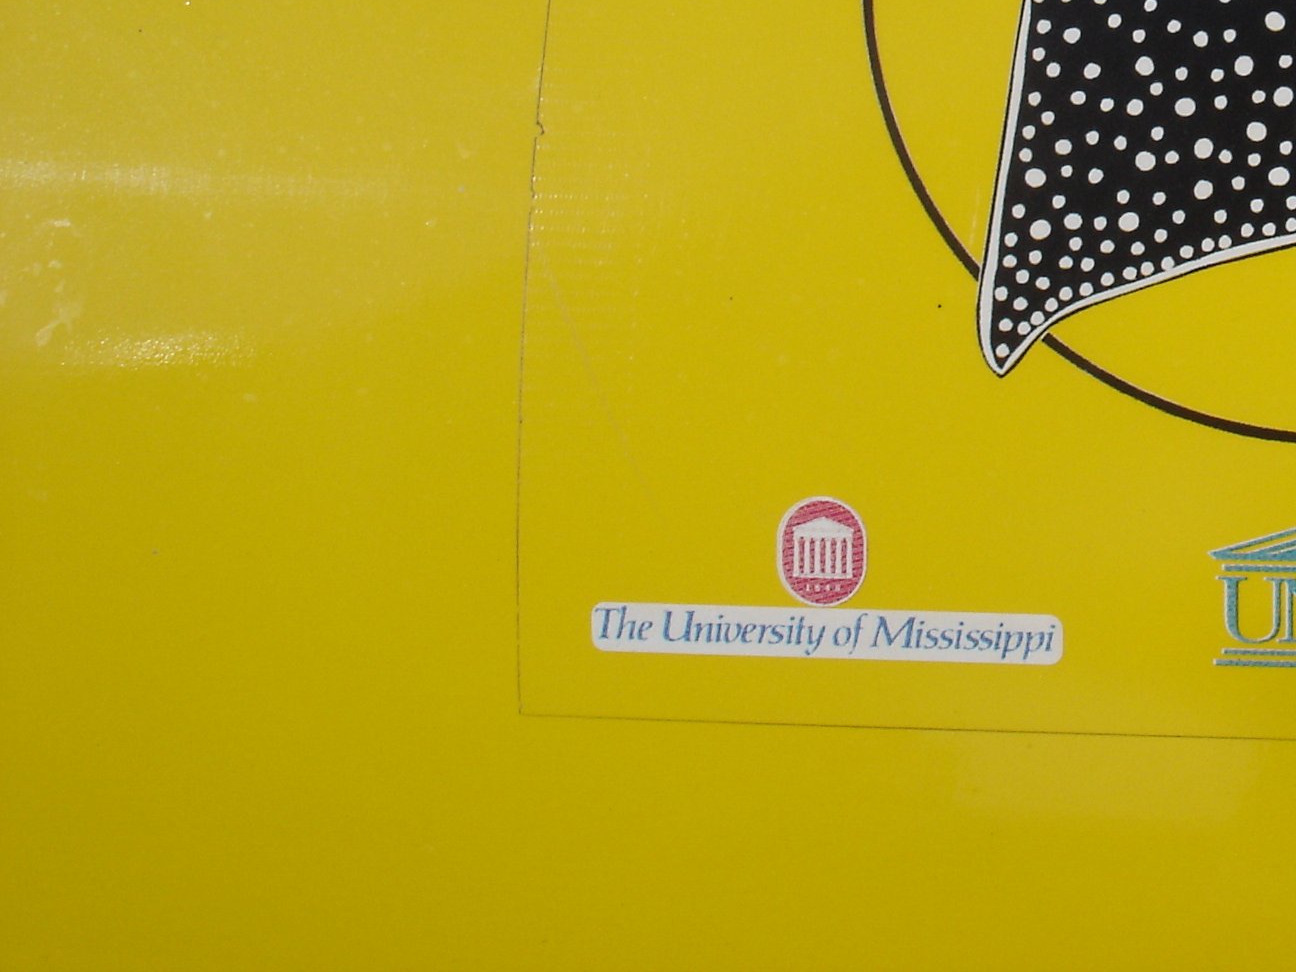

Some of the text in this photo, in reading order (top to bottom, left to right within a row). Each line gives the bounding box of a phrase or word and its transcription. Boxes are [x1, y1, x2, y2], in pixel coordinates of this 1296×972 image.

[594, 605, 1057, 661] The University of Mississippi
